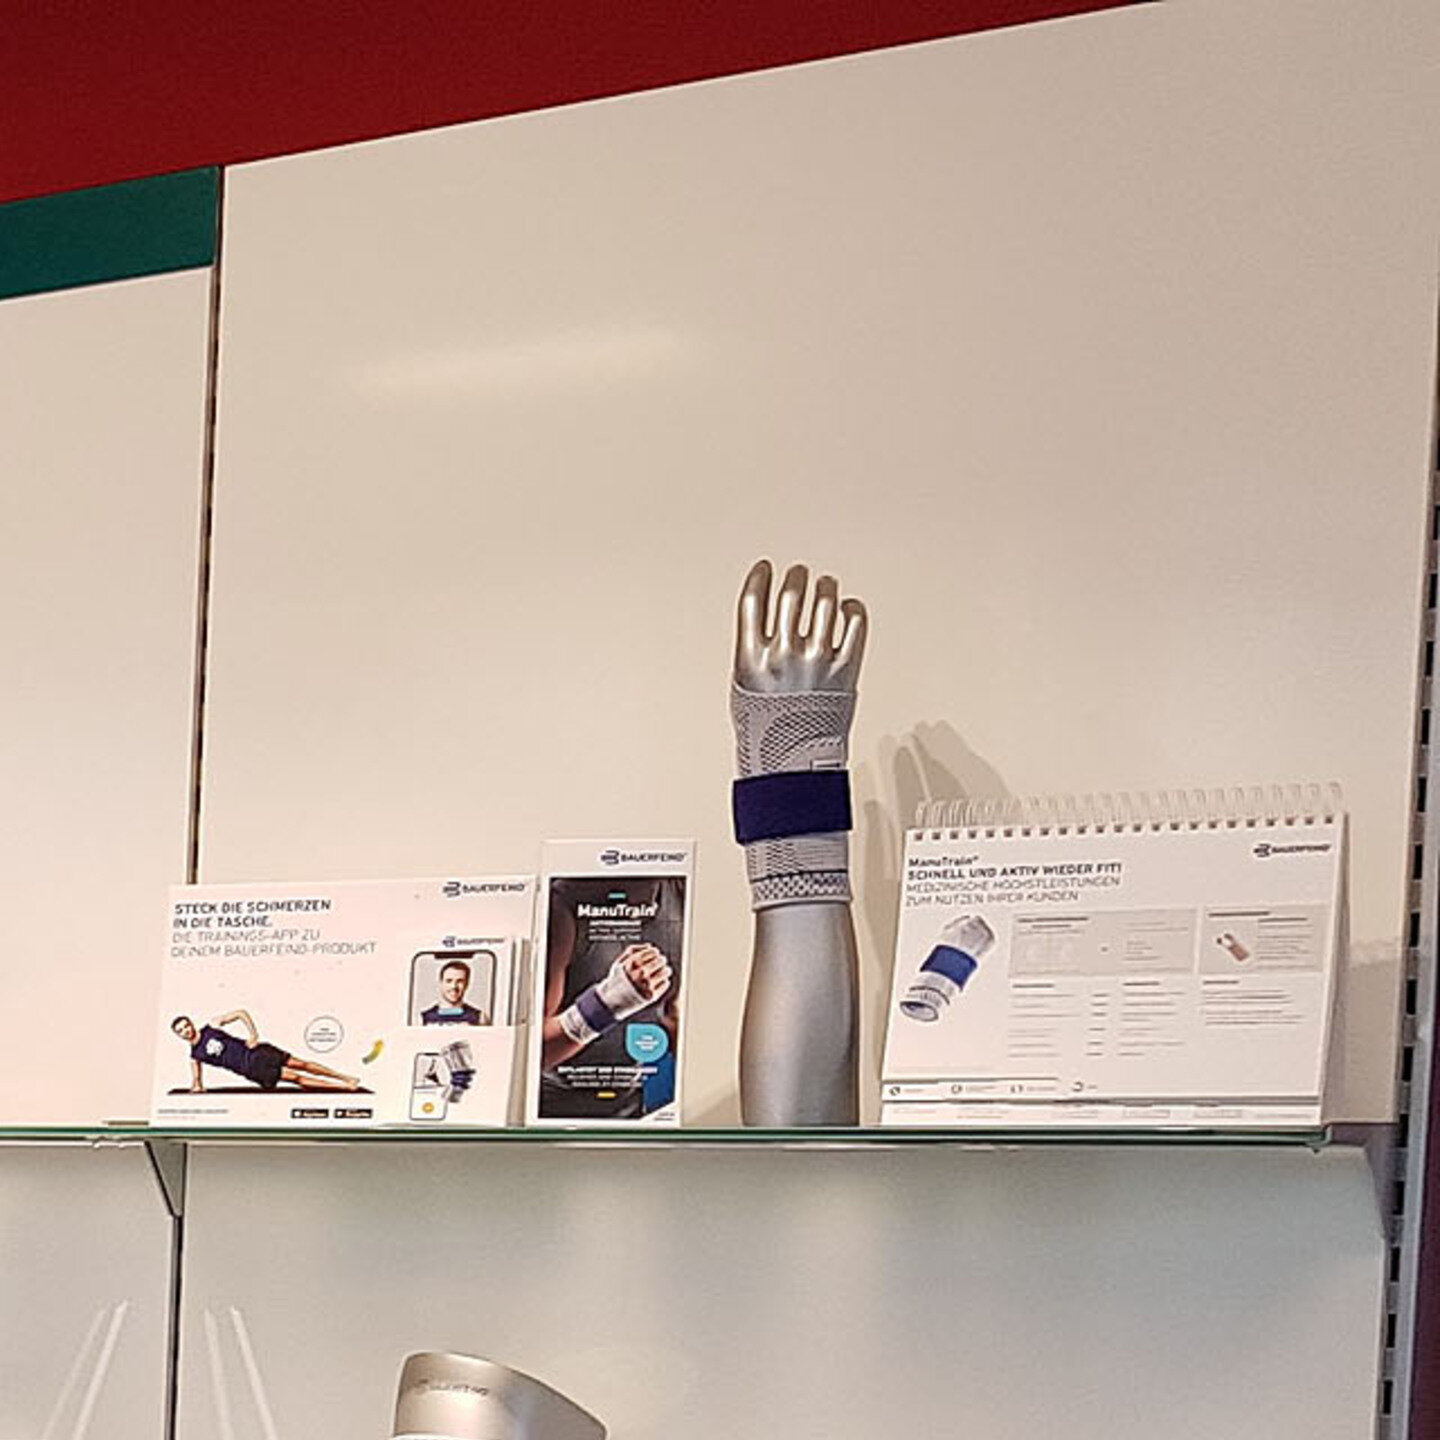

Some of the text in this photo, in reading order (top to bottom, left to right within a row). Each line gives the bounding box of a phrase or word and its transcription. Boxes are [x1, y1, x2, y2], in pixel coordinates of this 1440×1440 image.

[908, 868, 965, 880] SCHNELL
[969, 867, 997, 878] UND
[1000, 865, 1038, 877] AKTIV
[1042, 864, 1093, 875] WIEDER
[175, 899, 331, 915] STECK DIE SCHMERZEN
[173, 916, 187, 928] IN
[190, 916, 214, 928] DIE
